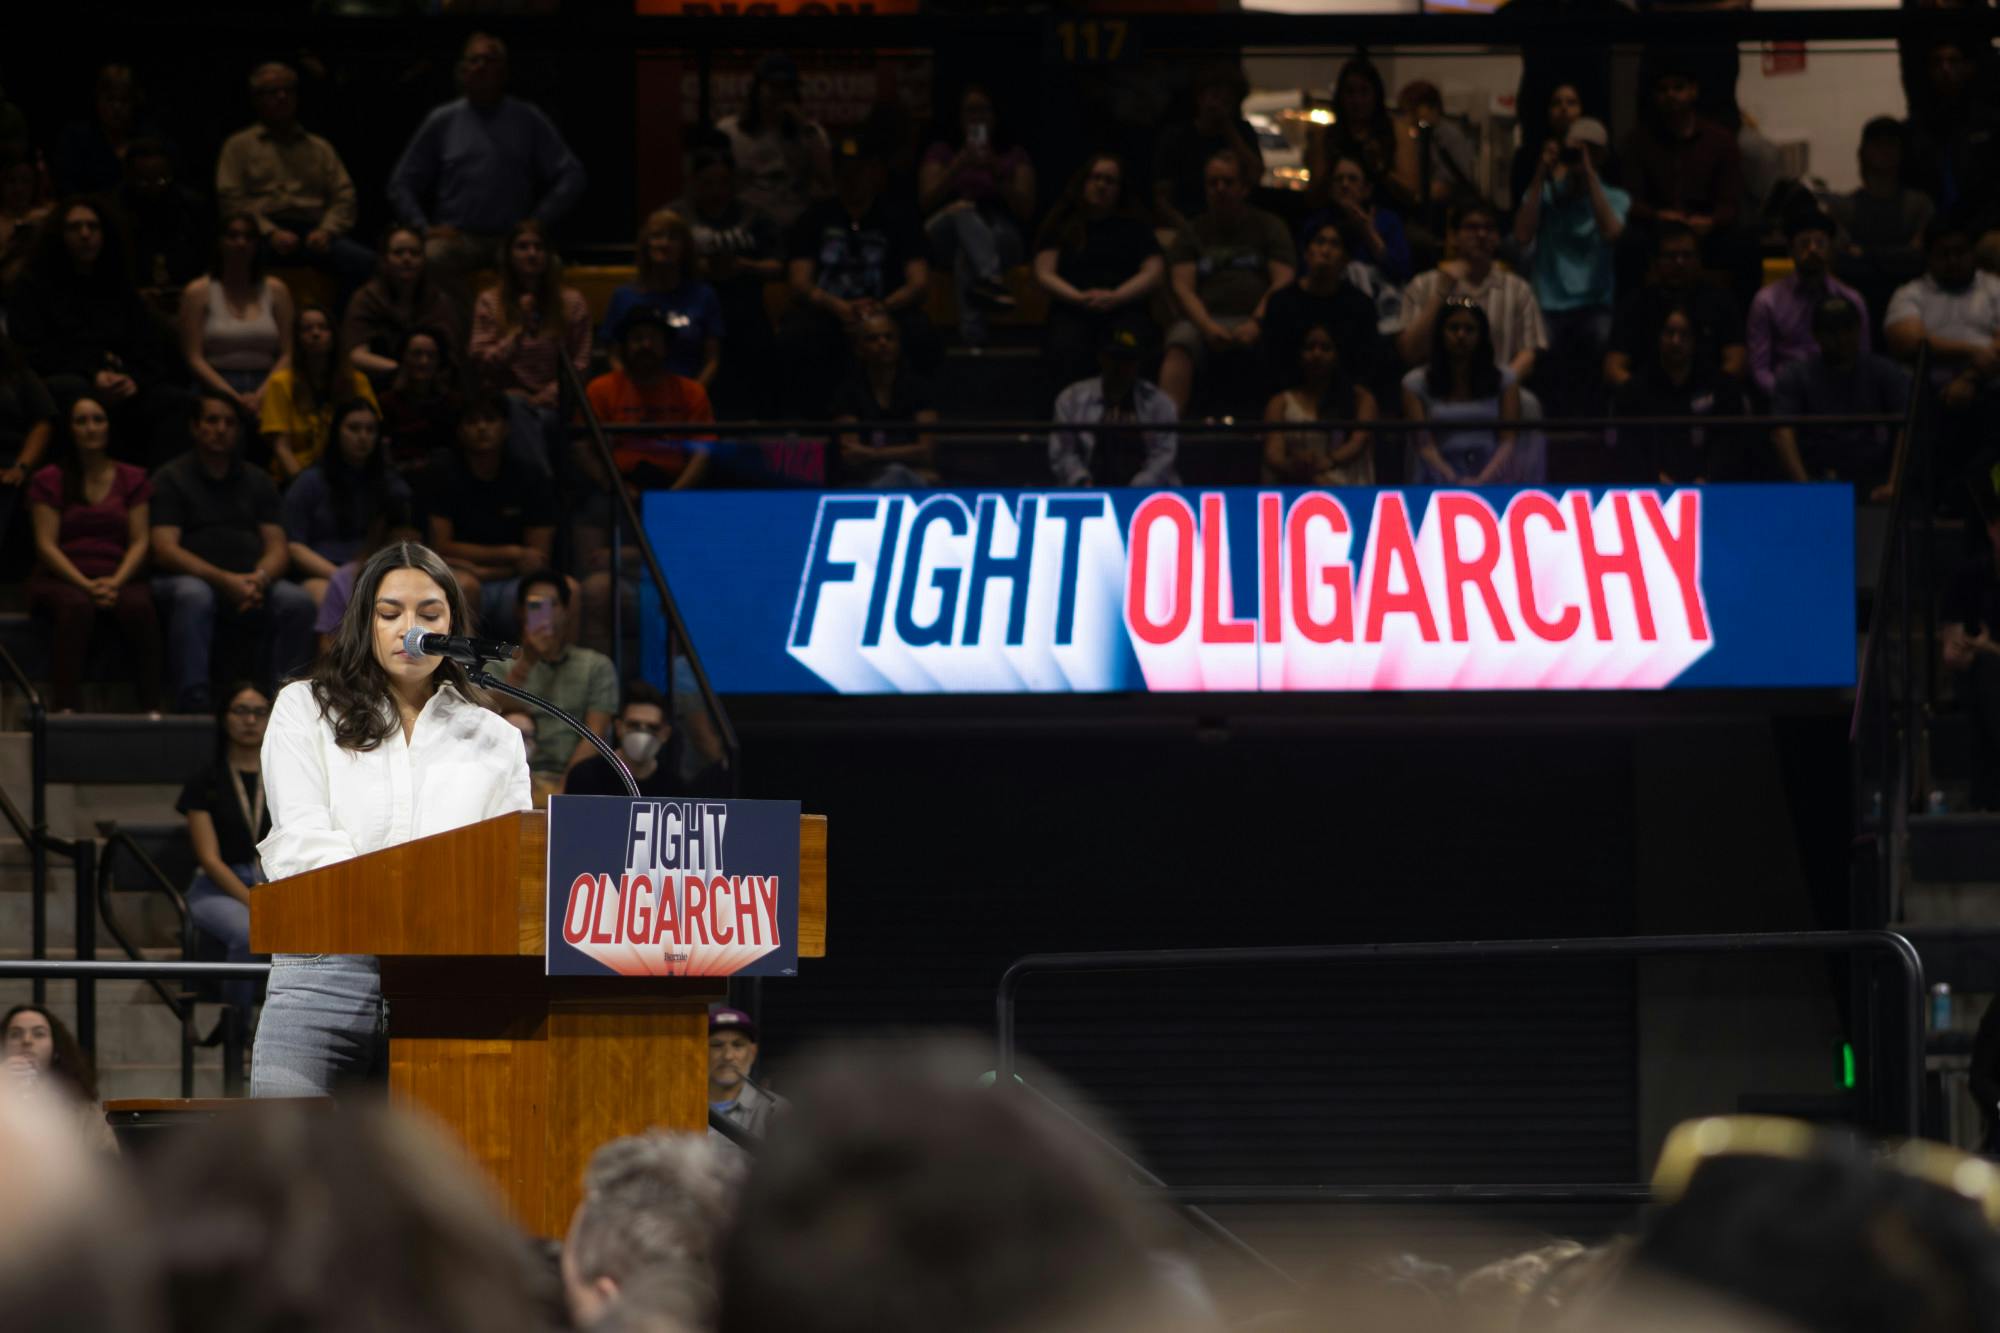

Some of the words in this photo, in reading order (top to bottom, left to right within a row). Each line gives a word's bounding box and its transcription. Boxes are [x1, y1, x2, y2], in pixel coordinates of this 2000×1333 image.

[1057, 20, 1129, 62] 117
[786, 491, 1112, 651] FIGHT
[1123, 488, 1714, 650] OLIGARCHY
[625, 801, 727, 870] FIGHT
[563, 872, 781, 947] OLIGARCHY
[664, 951, 688, 961] Bernie
